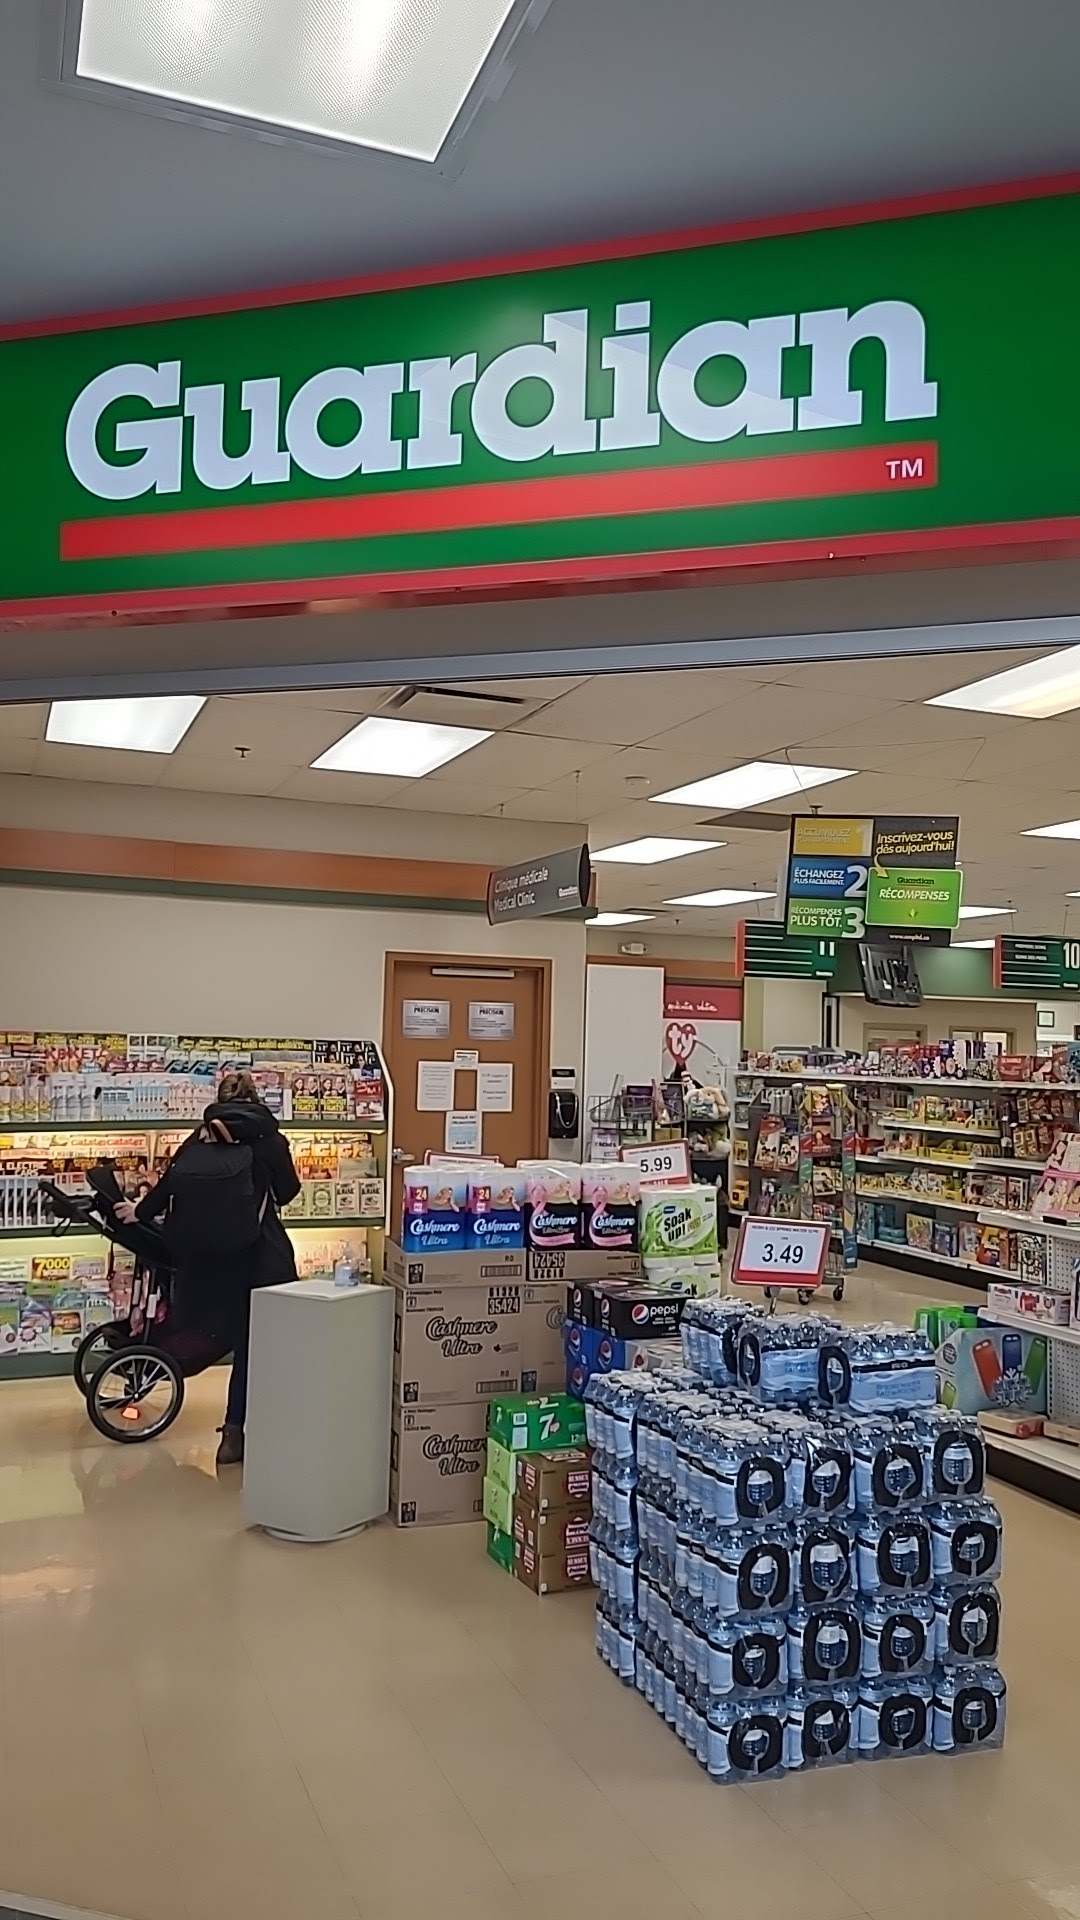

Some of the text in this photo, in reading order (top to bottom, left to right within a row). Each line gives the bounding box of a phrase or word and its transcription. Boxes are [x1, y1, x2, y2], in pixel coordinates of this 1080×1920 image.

[65, 300, 939, 501] Guardian
[885, 458, 923, 480] TM
[877, 831, 954, 845] Inscrivez-vous
[876, 840, 955, 856] dès aujourd'hui!
[519, 867, 549, 887] médicale
[794, 867, 845, 879] ÉCHANGEZ
[844, 865, 868, 897] 2
[896, 876, 936, 886] Guardian
[517, 890, 536, 907] Clinic
[879, 888, 950, 901] RÉCOMPENSES
[790, 906, 842, 916] RÉCOMPENSES
[790, 914, 843, 928] PLUS TÔT.
[841, 906, 866, 939] 3
[1062, 942, 1080, 969] 10
[668, 1025, 694, 1059] ty
[640, 1156, 672, 1174] 5.99
[410, 1218, 460, 1236] Cashmere
[473, 1218, 521, 1235] Cashmere
[532, 1213, 578, 1230] Cashmere
[592, 1214, 636, 1230] Cashmere
[663, 1208, 692, 1232] Soak
[421, 1235, 448, 1246] Ultra
[484, 1234, 510, 1246] Ultra
[668, 1223, 686, 1243] up!
[534, 1252, 564, 1268] 35424
[762, 1243, 804, 1264] 3.49
[33, 1257, 70, 1279] 7000
[489, 1298, 519, 1314] 35424
[650, 1303, 679, 1317] pepsi
[426, 1315, 498, 1341] Cashmere
[441, 1339, 483, 1358] Ultra
[422, 1434, 488, 1460] Cashmer
[438, 1458, 481, 1477] Ultra
